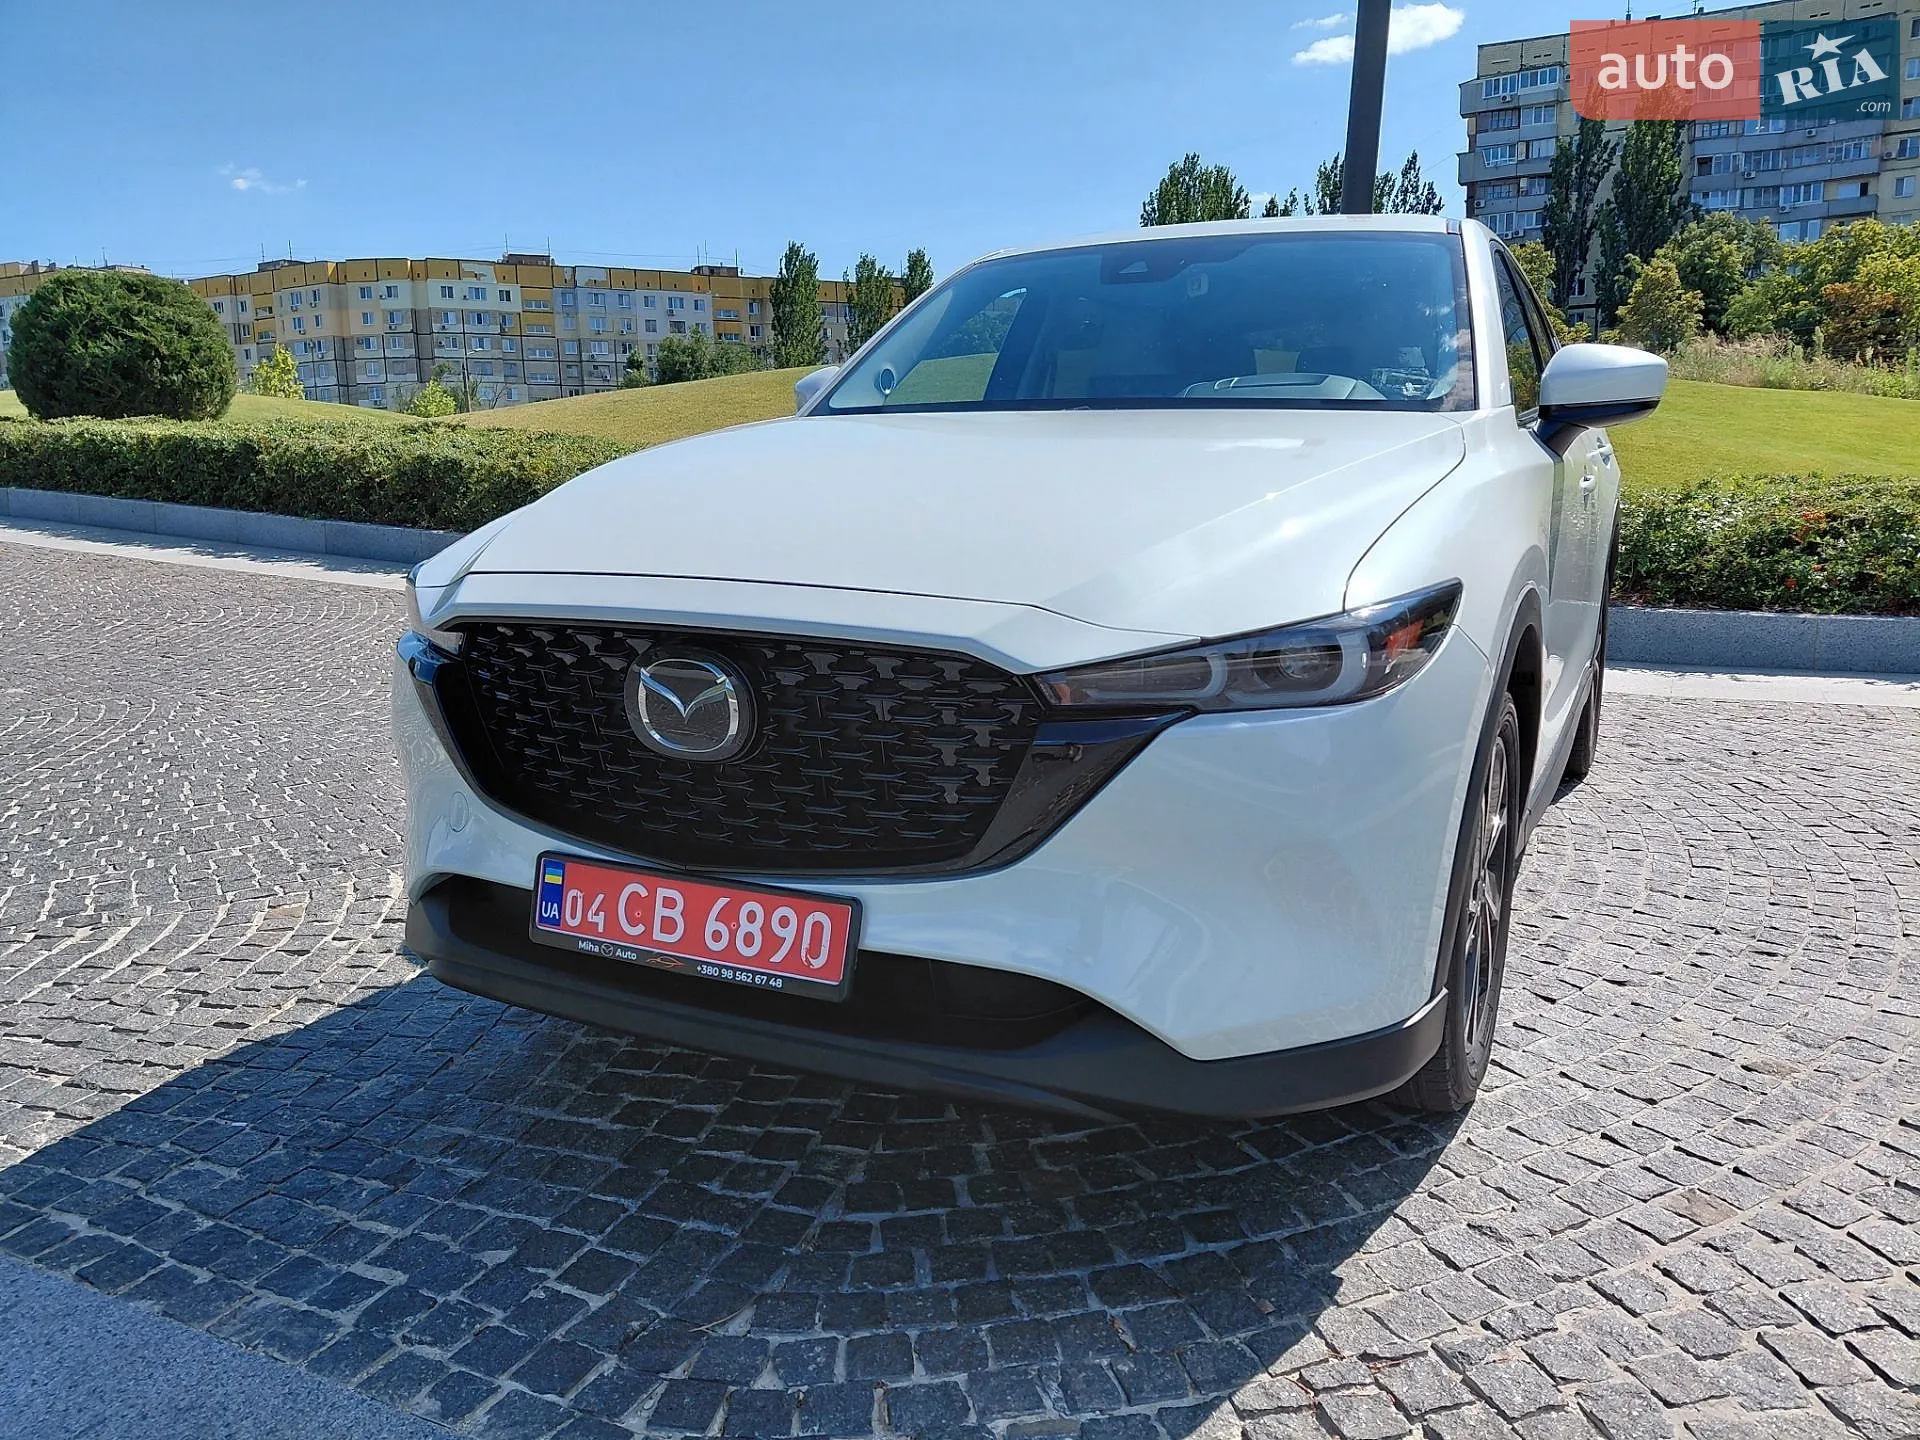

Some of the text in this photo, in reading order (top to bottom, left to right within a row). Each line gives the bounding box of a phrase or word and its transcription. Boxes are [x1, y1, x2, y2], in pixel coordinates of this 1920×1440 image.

[541, 901, 559, 920] UA
[565, 883, 832, 969] 04 CB 6890
[578, 940, 783, 989] Miha Auto +380 98 562 67 48
